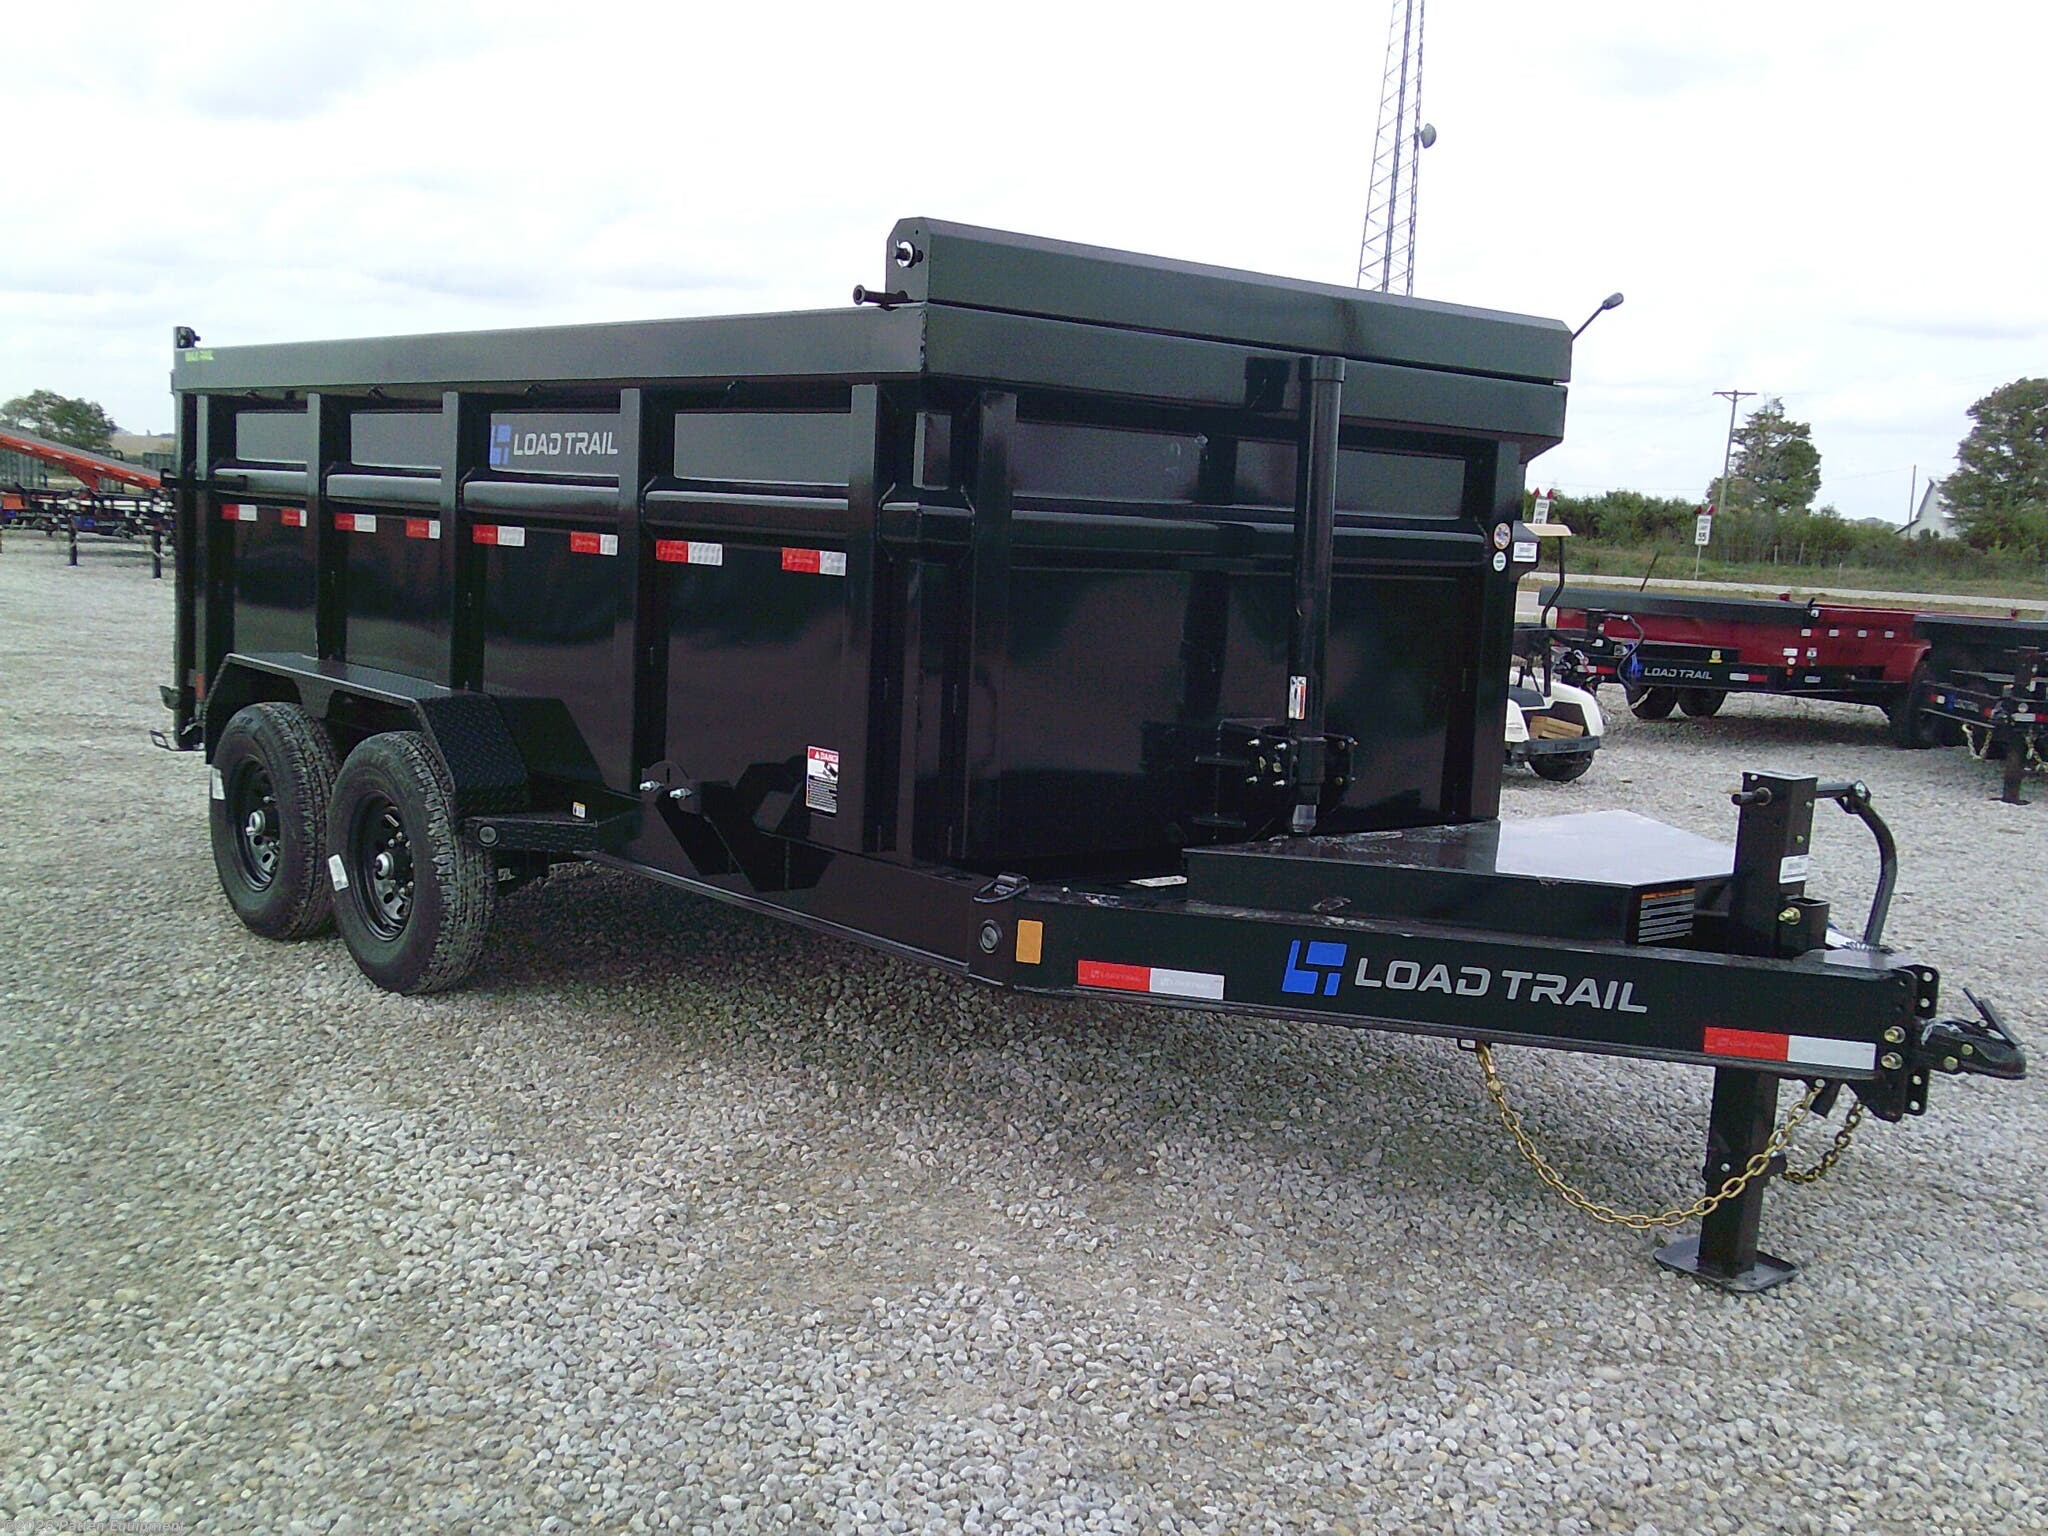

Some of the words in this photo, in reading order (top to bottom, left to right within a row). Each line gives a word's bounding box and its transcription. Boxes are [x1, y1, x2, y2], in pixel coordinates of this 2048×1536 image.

[513, 433, 562, 456] LOAD
[565, 431, 619, 455] TRAIL
[1644, 667, 1678, 678] LOAD
[1678, 669, 1713, 680] TRAIL
[1354, 957, 1491, 997] LOAD
[1501, 970, 1649, 1014] TRAIL
